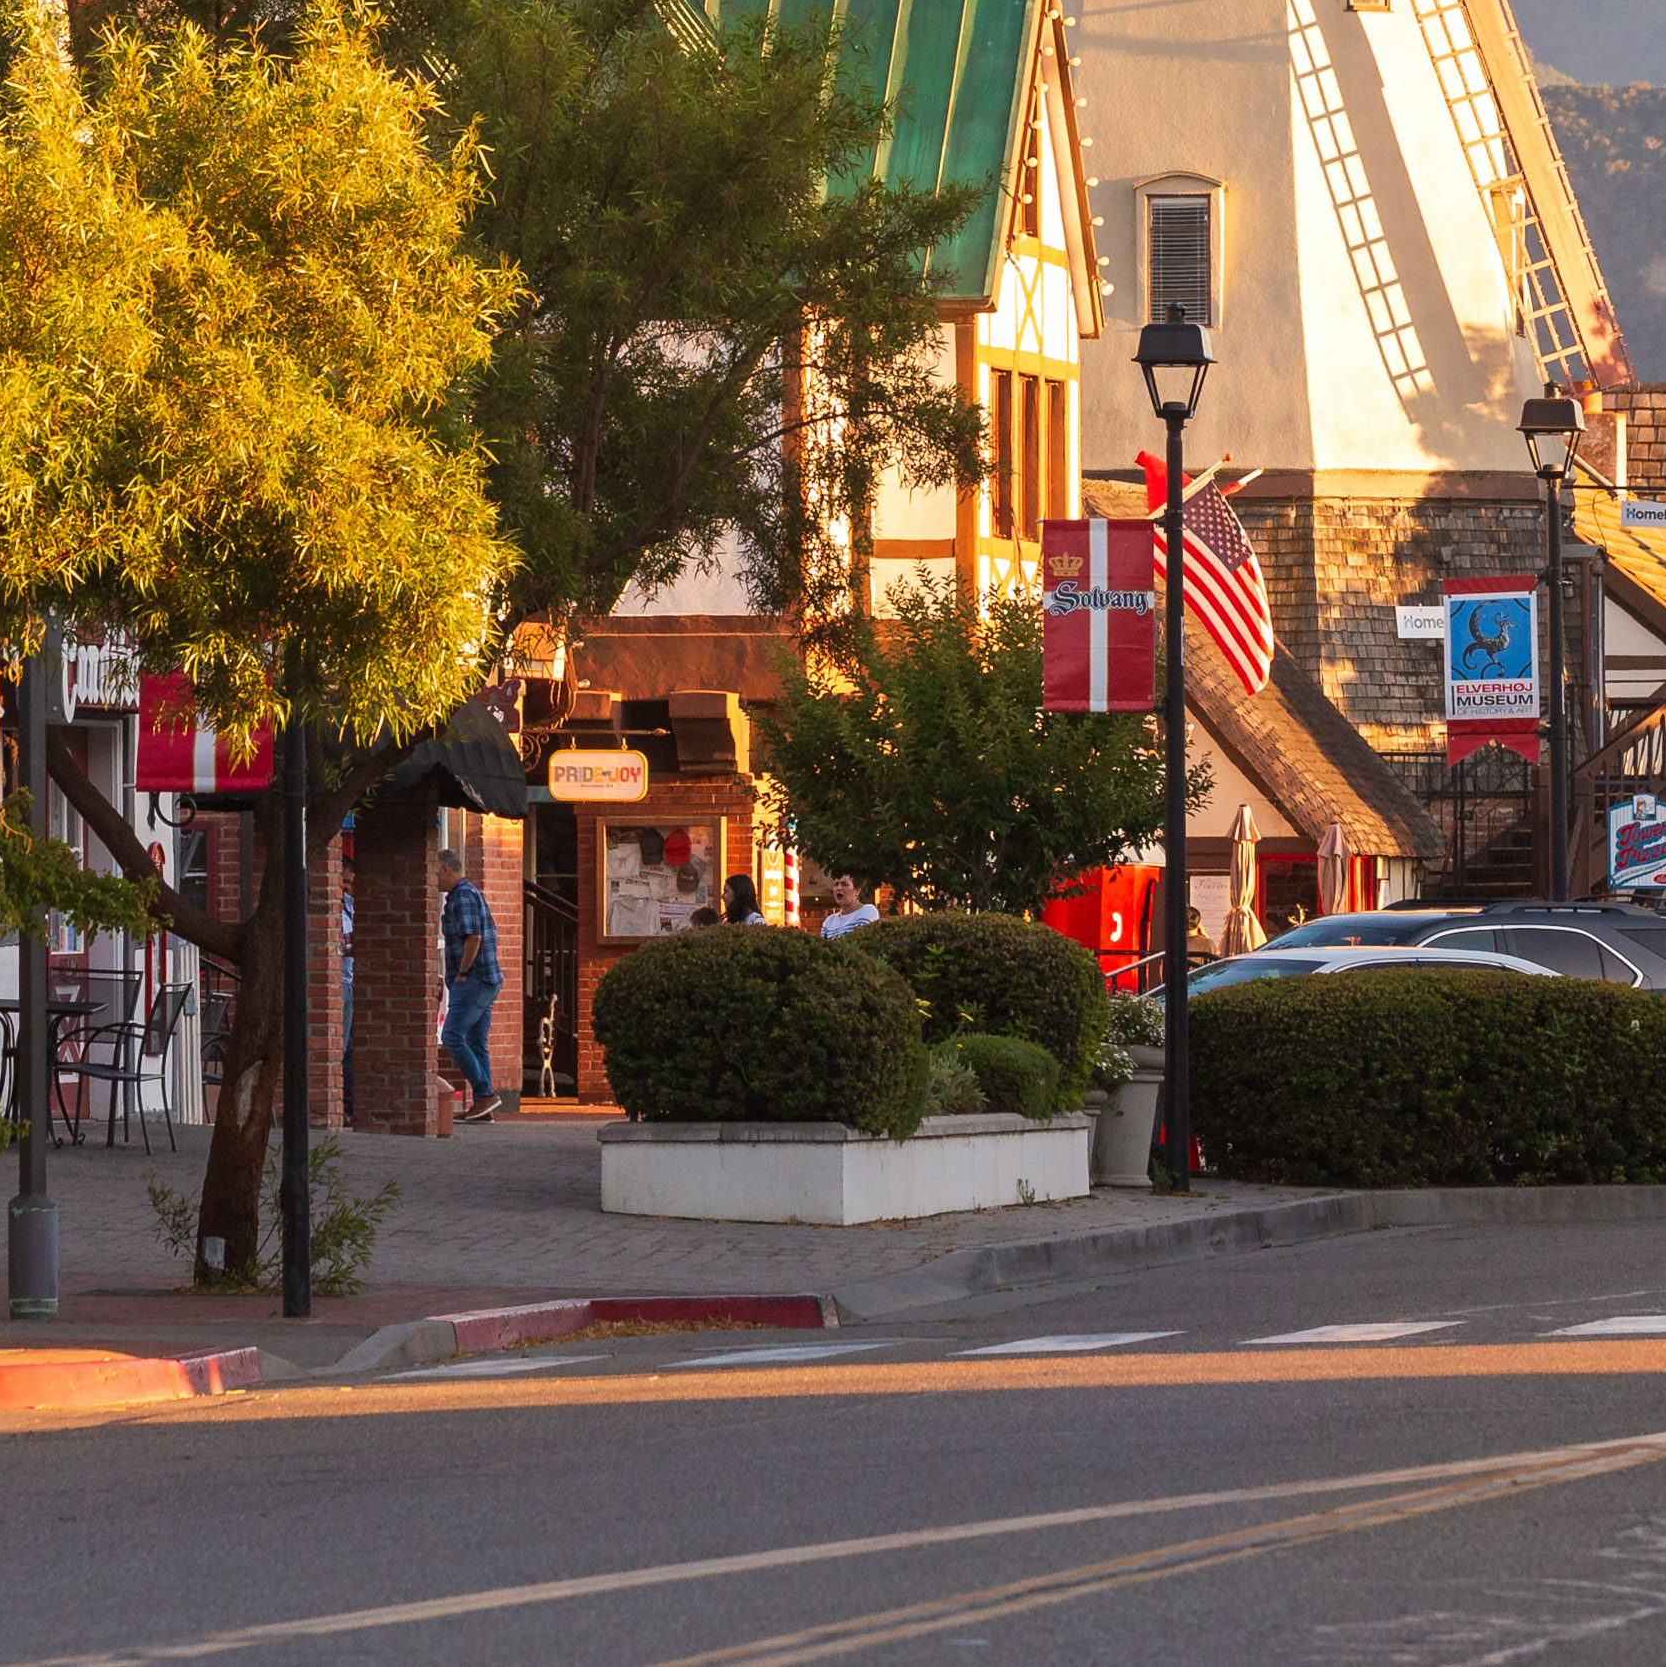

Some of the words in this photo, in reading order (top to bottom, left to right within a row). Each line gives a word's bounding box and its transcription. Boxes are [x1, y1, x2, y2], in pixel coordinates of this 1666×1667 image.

[1049, 580, 1148, 615] Solvang
[1456, 683, 1533, 694] ELVERHØJ
[1456, 695, 1533, 707] MUSEUM
[1471, 705, 1507, 715] HISTORY
[554, 765, 605, 783] PRIDE
[609, 766, 642, 783] JOY
